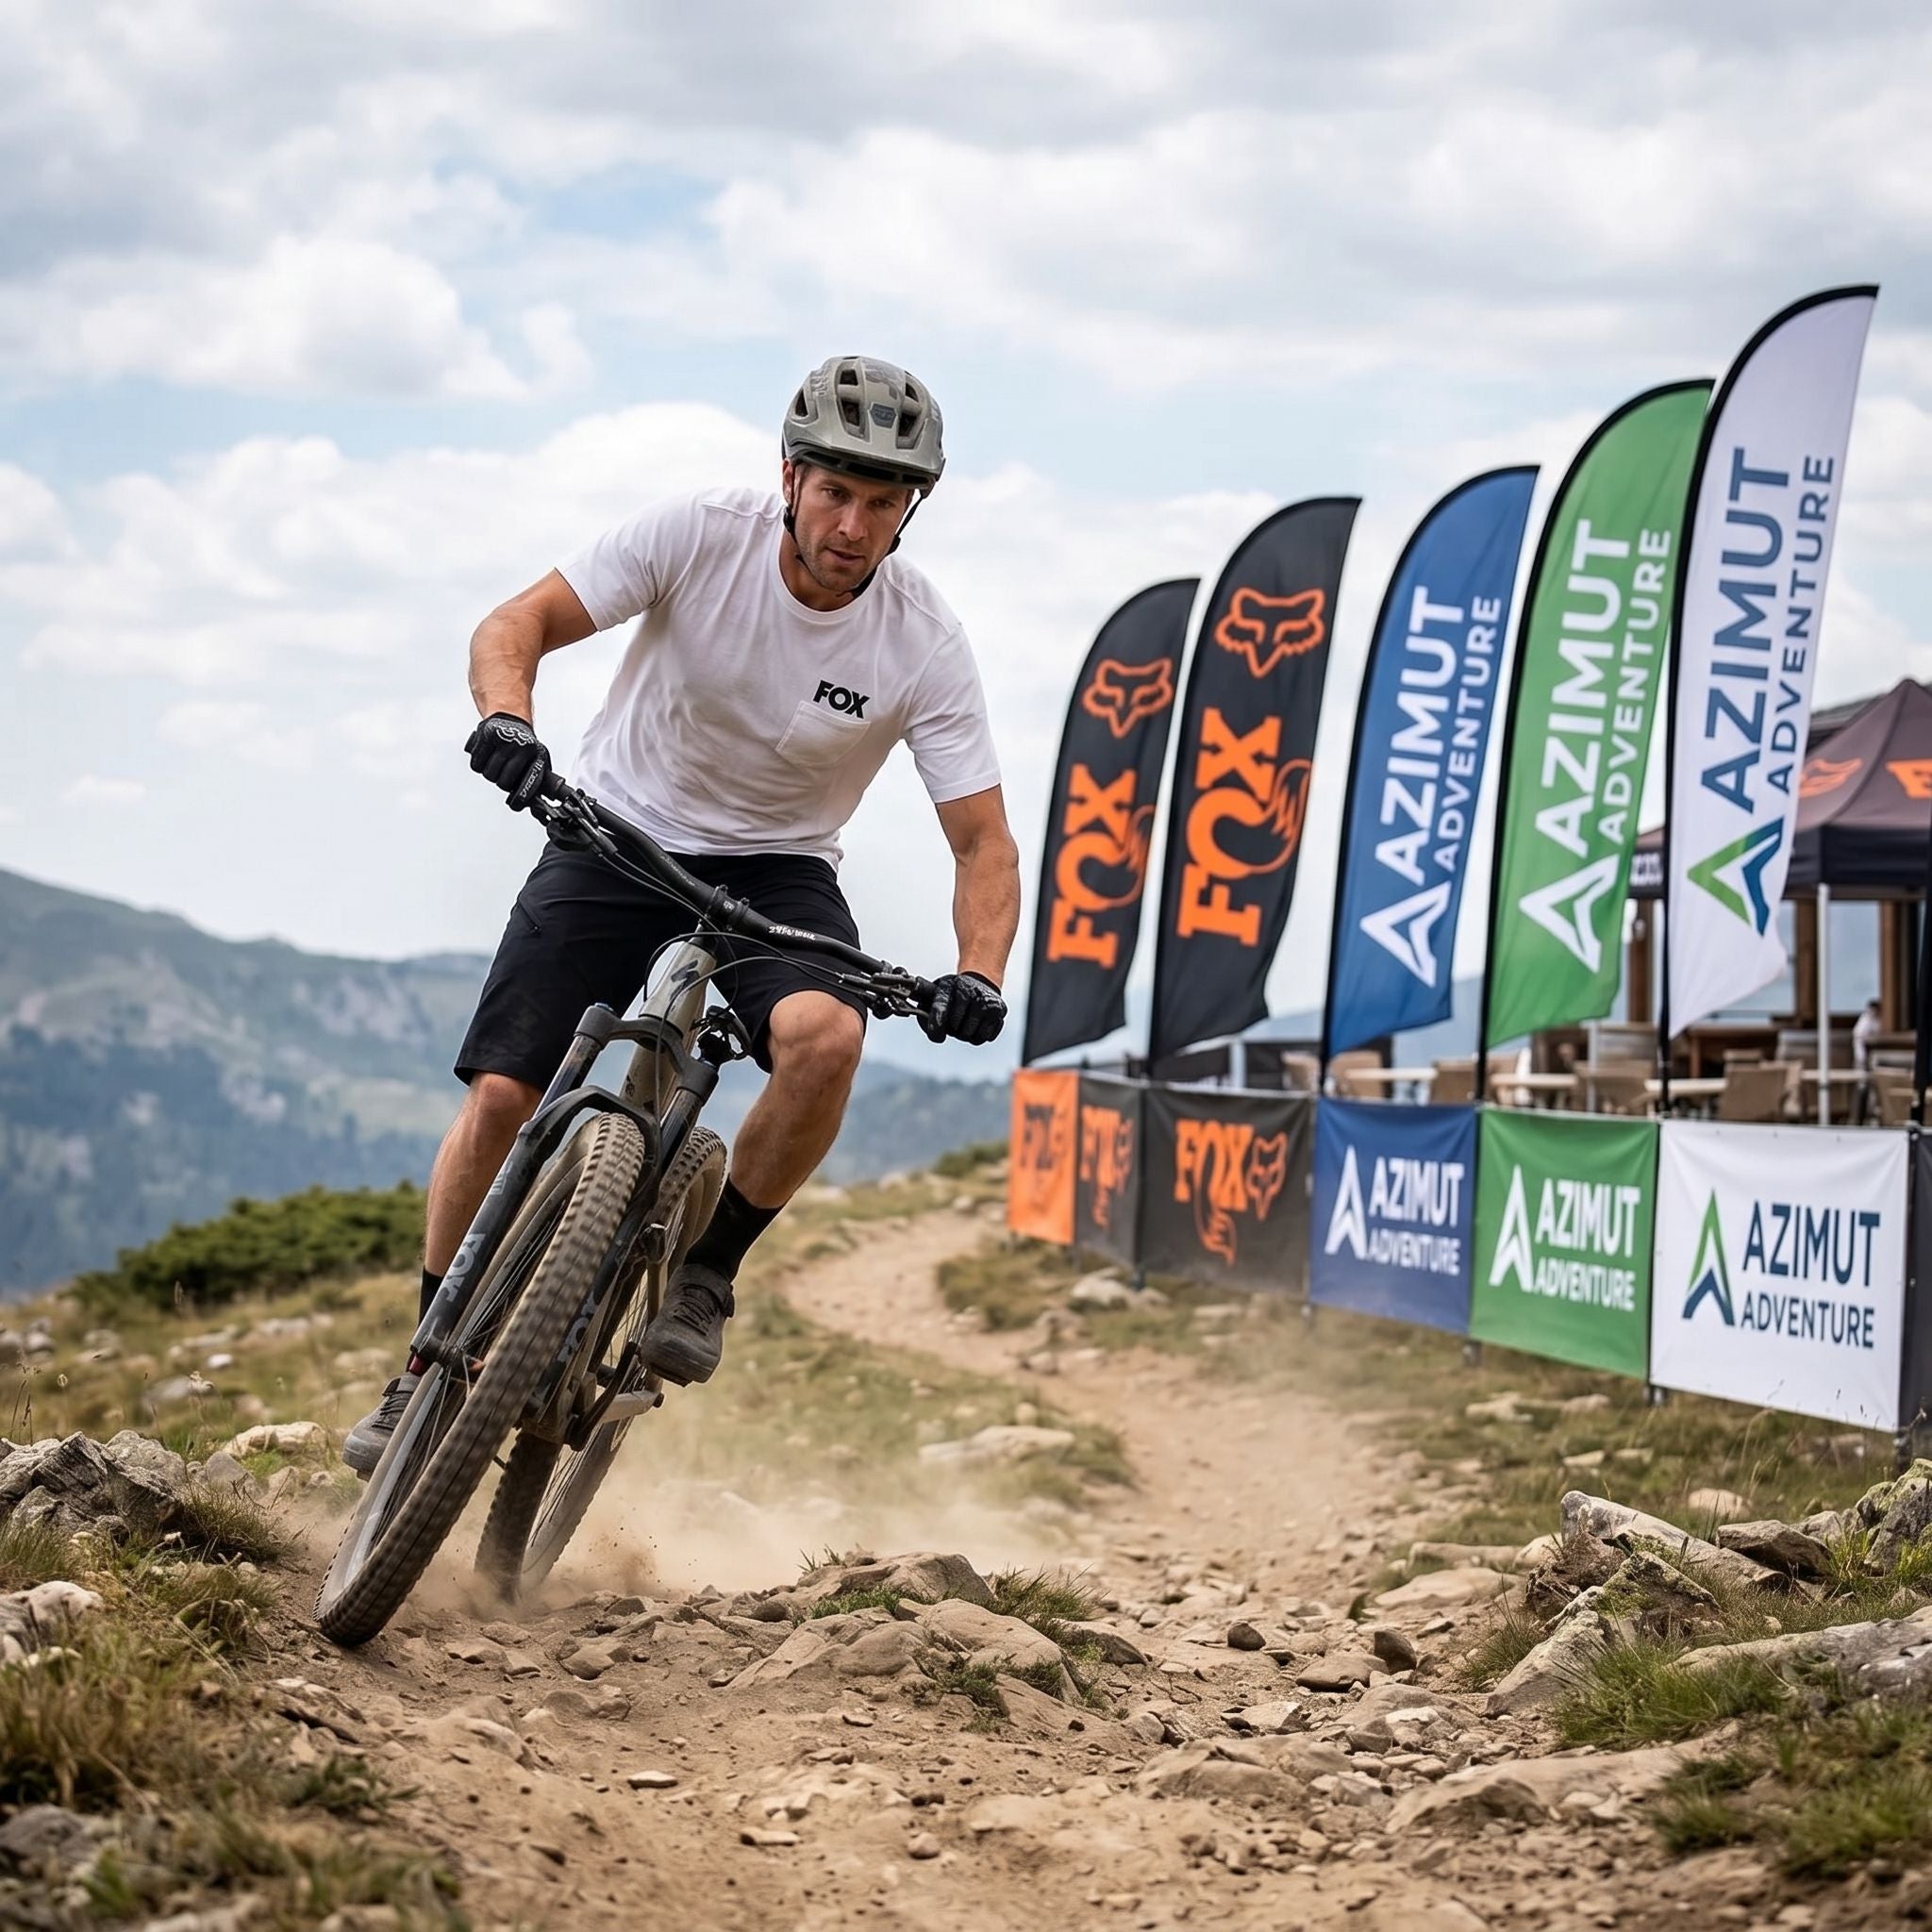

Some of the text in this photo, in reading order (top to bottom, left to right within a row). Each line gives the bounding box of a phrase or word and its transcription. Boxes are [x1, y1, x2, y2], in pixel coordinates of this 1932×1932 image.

[812, 679, 870, 719] FOX
[1534, 518, 1631, 858] AZIMUT
[1597, 528, 1672, 845] ADVENTURE
[1700, 446, 1790, 816] AZIMUT
[1765, 455, 1835, 796] ADVENTURE
[1177, 707, 1311, 946] FOX
[1374, 586, 1464, 887] AZIMUT
[1433, 595, 1502, 873] ADVENTURE
[1047, 763, 1153, 970] FOX
[1367, 1231, 1460, 1276] ADVENTURE
[1368, 1157, 1465, 1226] AZIMUT
[1532, 1256, 1636, 1311] ADVENTURE
[1535, 1177, 1641, 1257] AZIMUT
[1742, 1200, 1881, 1288] AZIMUT
[1740, 1291, 1875, 1350] ADVENTURE
